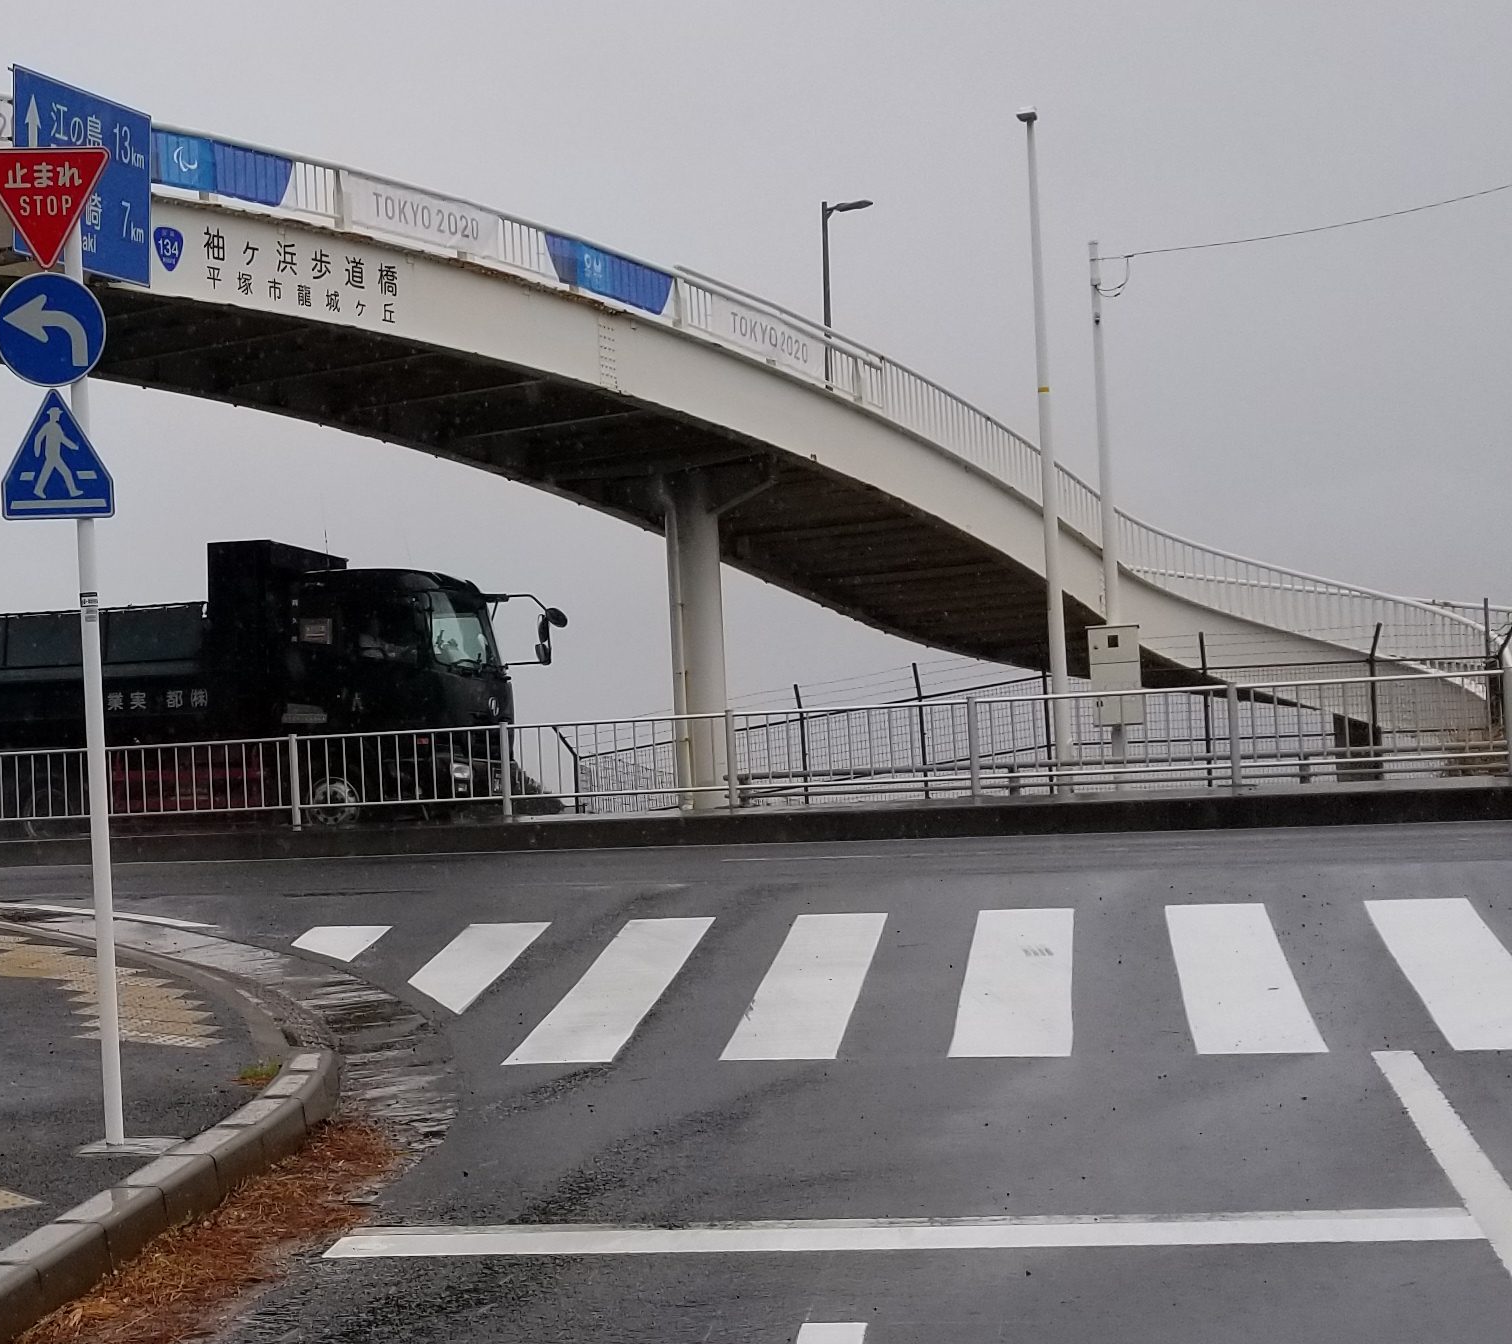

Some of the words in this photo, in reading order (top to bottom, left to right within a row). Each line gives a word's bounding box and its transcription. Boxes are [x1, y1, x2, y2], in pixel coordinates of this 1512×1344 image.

[4, 162, 83, 189] 止まれ
[20, 195, 72, 216] STOP
[372, 192, 431, 230] TOKYO
[436, 209, 479, 240] 2020
[158, 237, 179, 258] 134
[731, 312, 778, 348] TOKYO
[780, 331, 808, 364] 2020
